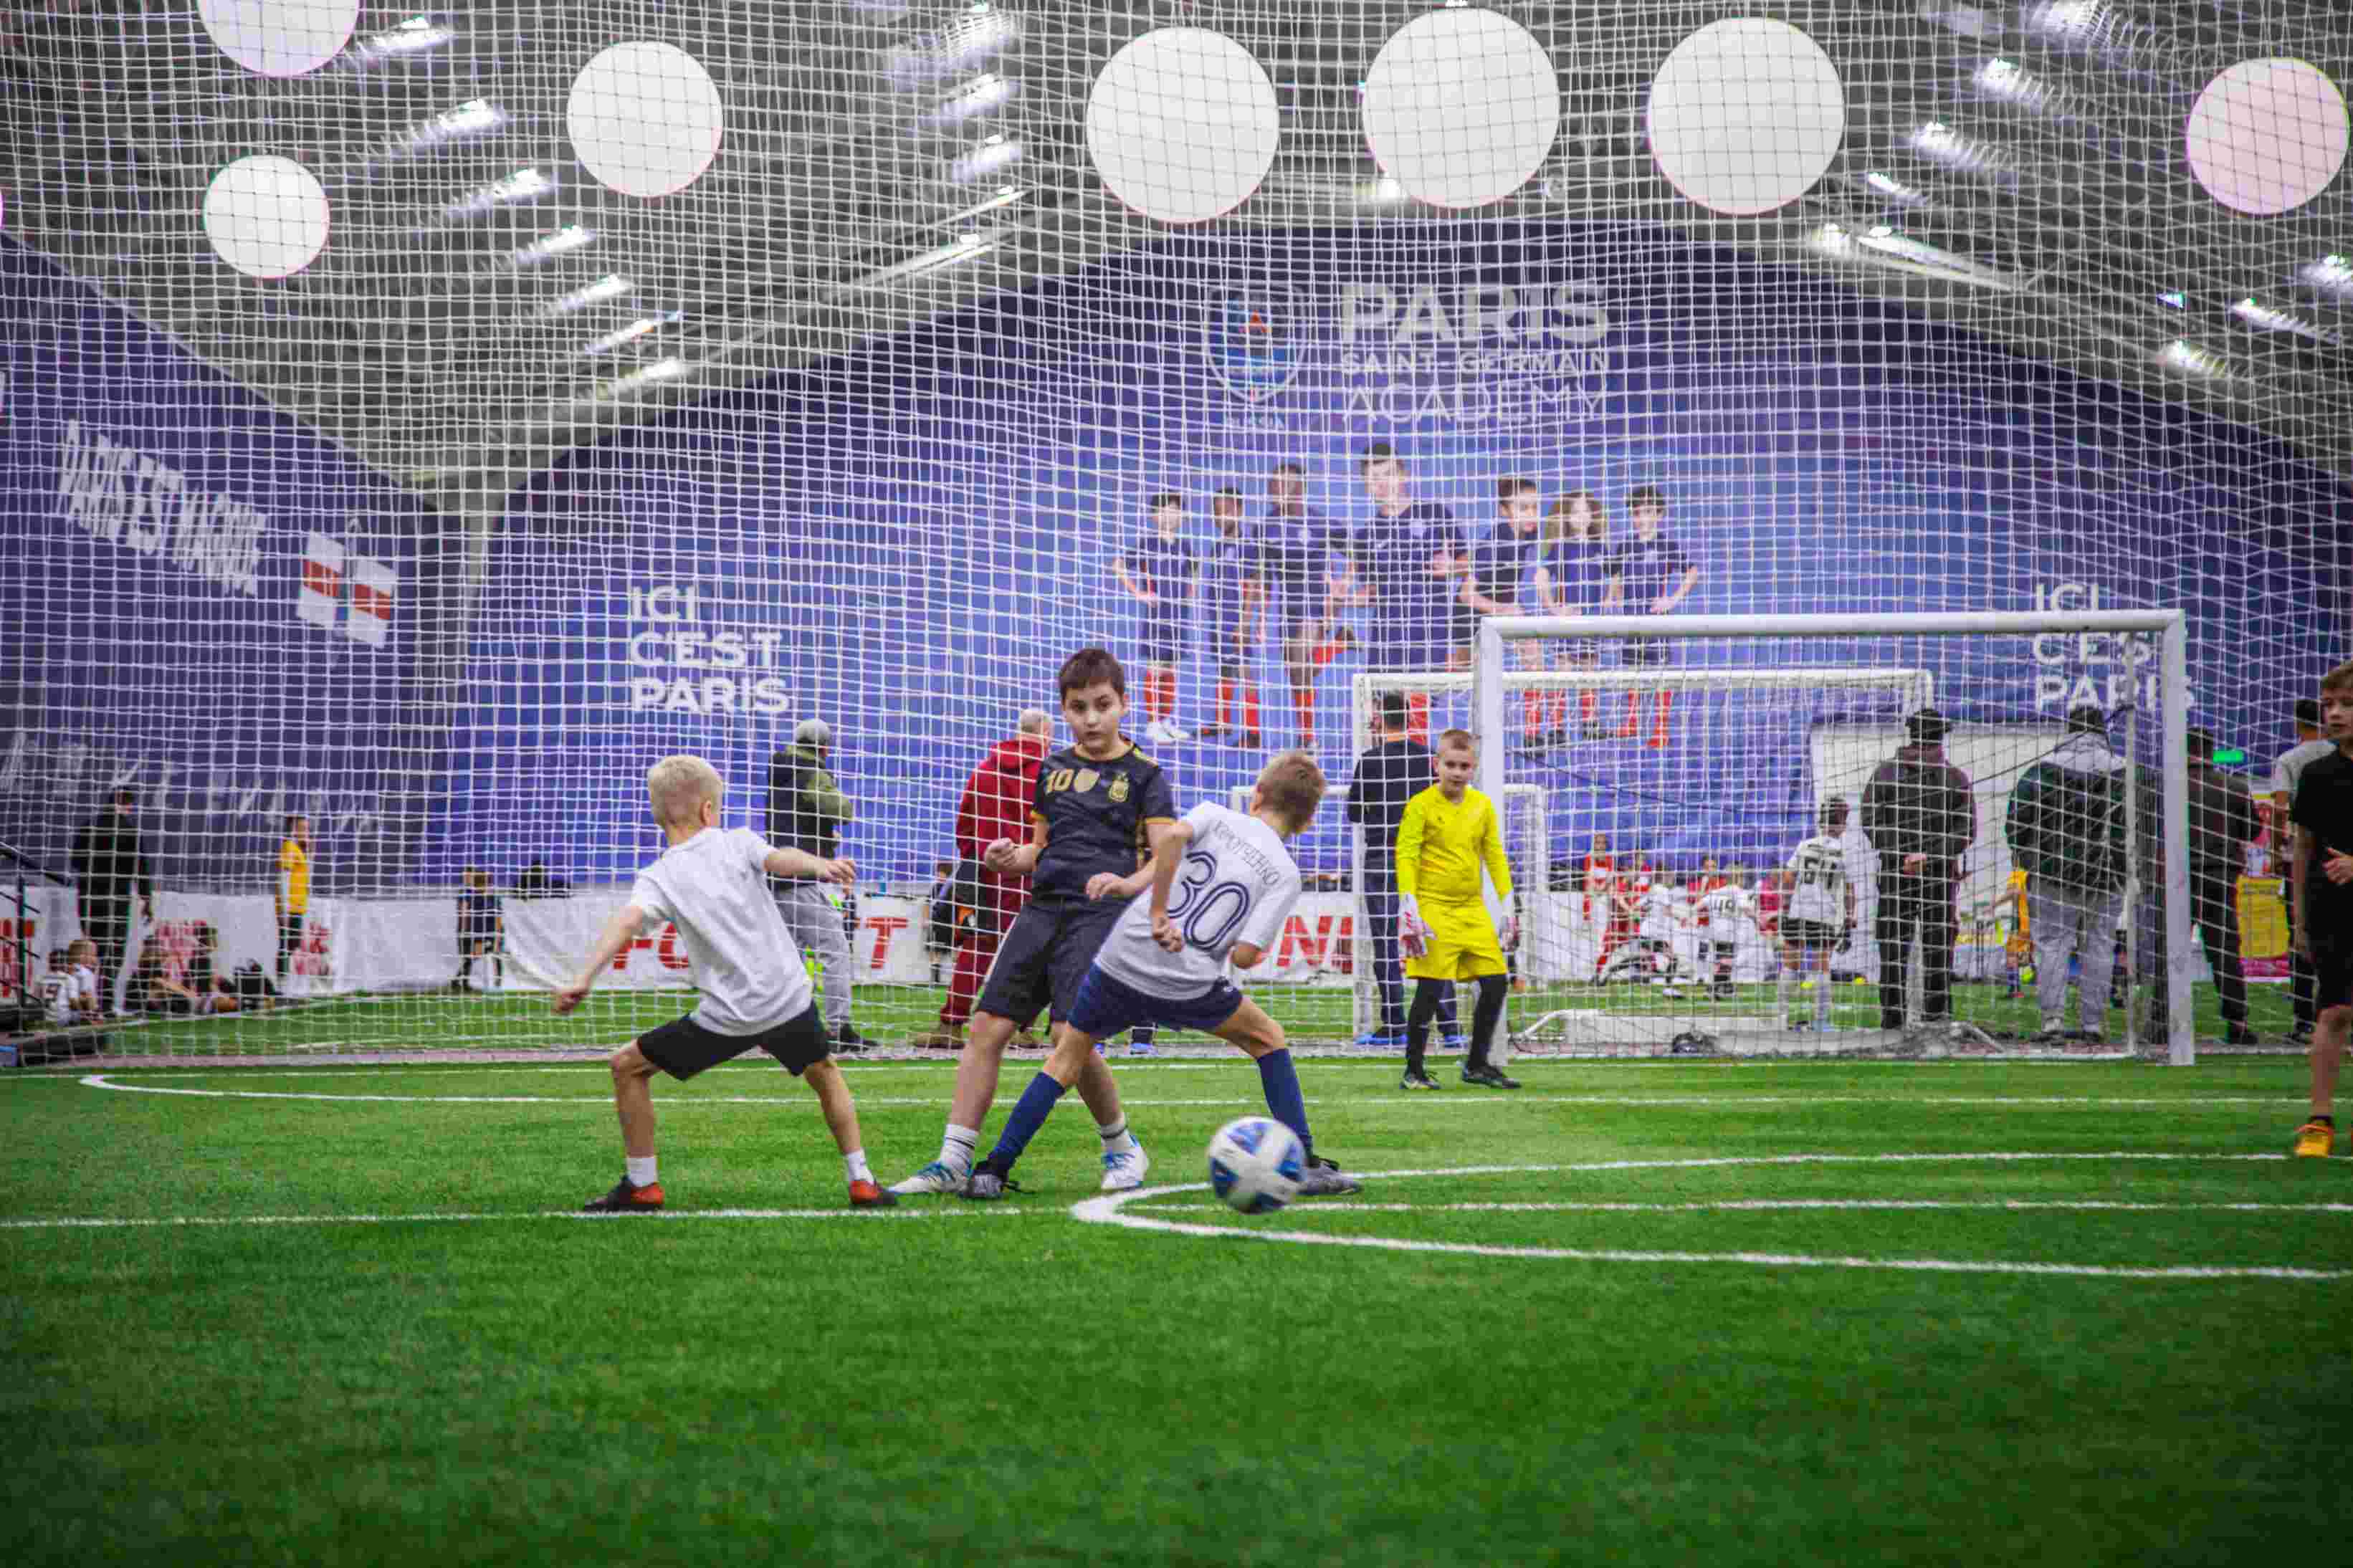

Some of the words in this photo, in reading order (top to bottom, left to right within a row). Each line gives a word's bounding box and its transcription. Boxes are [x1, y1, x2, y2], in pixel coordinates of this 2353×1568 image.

[1342, 282, 1608, 344] PARIS
[1343, 383, 1606, 424] ACADEMY
[631, 585, 696, 621] ICI
[632, 677, 789, 712] PARIS
[1046, 768, 1074, 796] 10
[1166, 850, 1250, 951] 30
